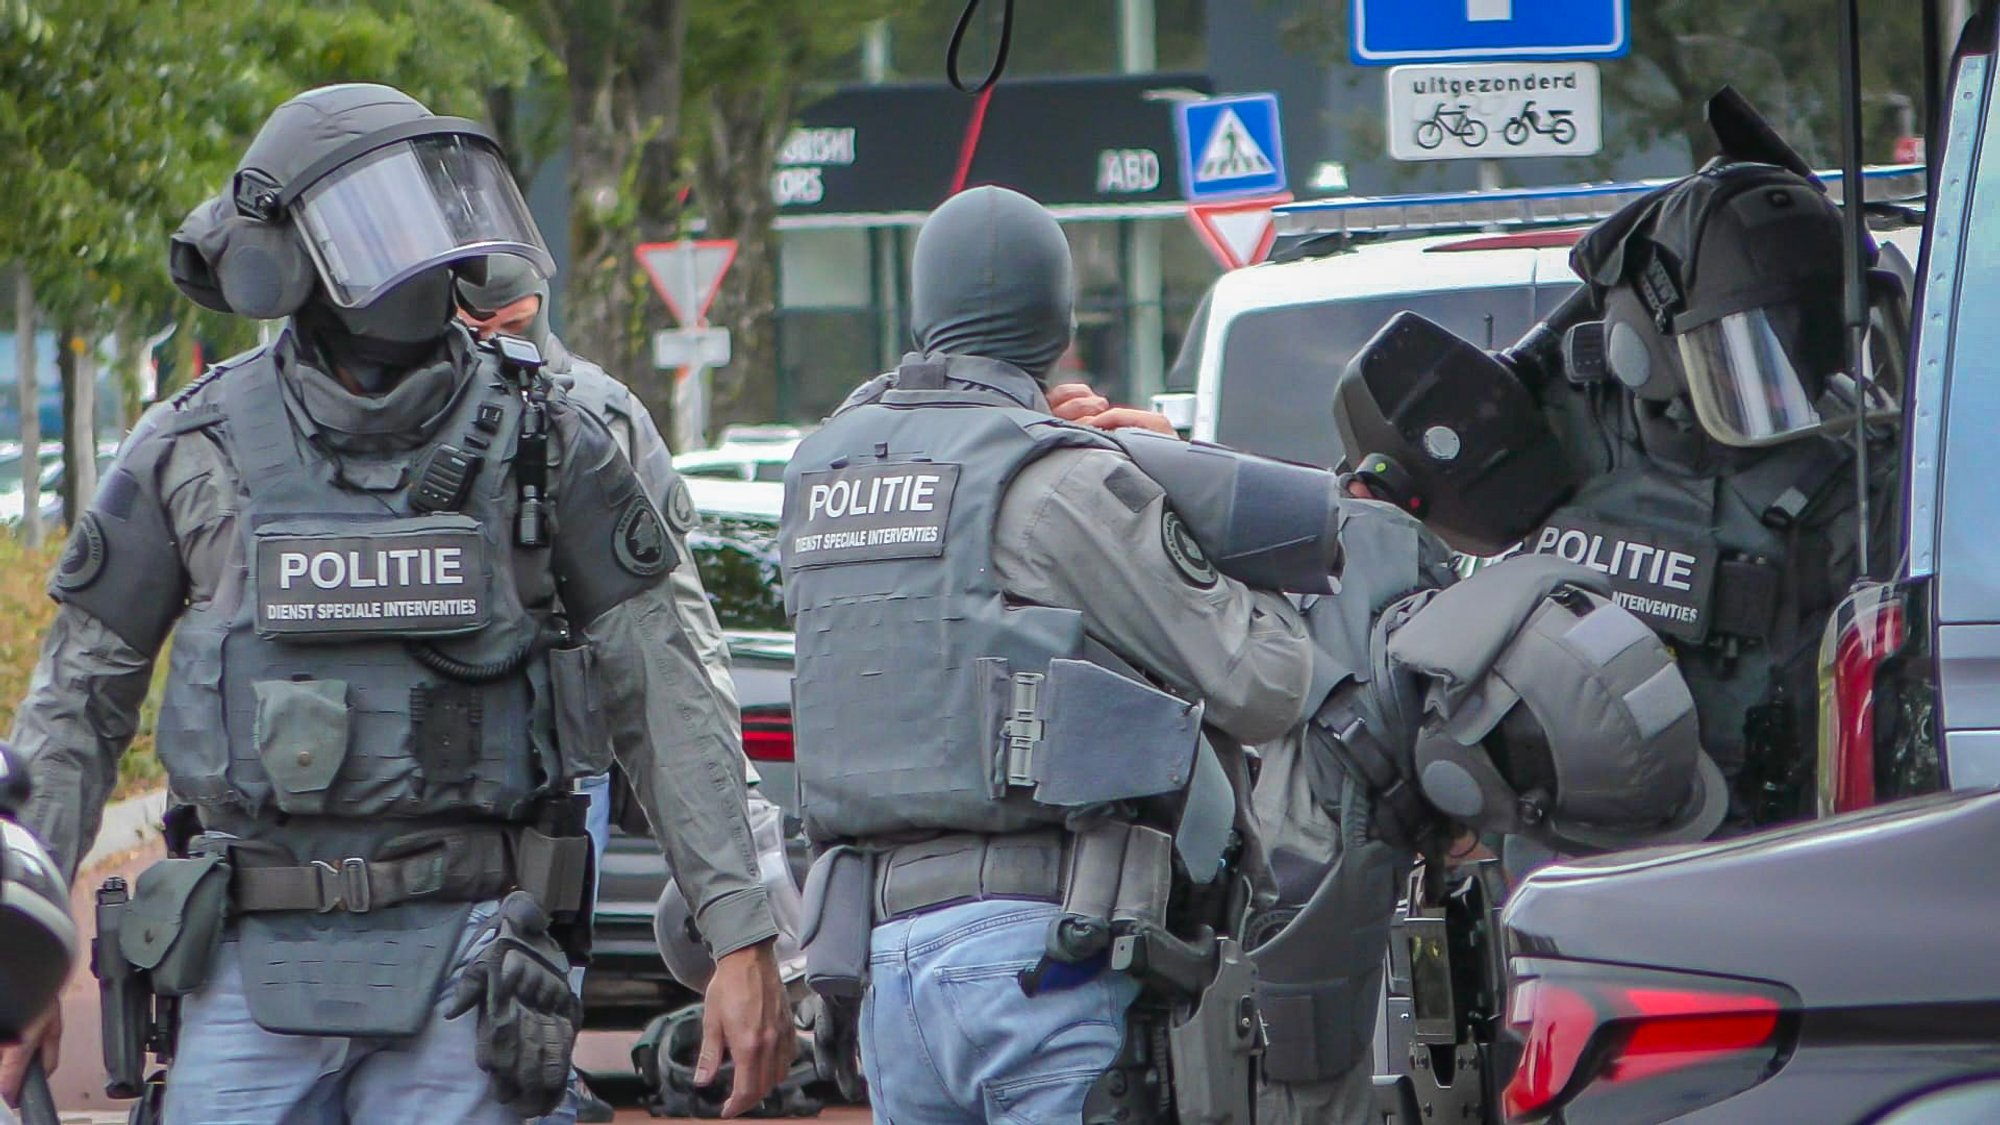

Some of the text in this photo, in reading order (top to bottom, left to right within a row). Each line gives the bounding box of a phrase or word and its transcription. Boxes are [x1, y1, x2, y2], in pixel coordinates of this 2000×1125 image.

[1412, 71, 1577, 97] uitgezonderd
[809, 475, 940, 522] POLITIE
[823, 530, 867, 550] SPECIALE
[867, 526, 938, 546] INTERVENTIES
[280, 548, 464, 589] POLITIE
[1534, 526, 1696, 591] POLITIE
[267, 599, 477, 620] DIENST SPECIALE INTERVENTIES
[1611, 591, 1698, 623] NTERVENTIES
